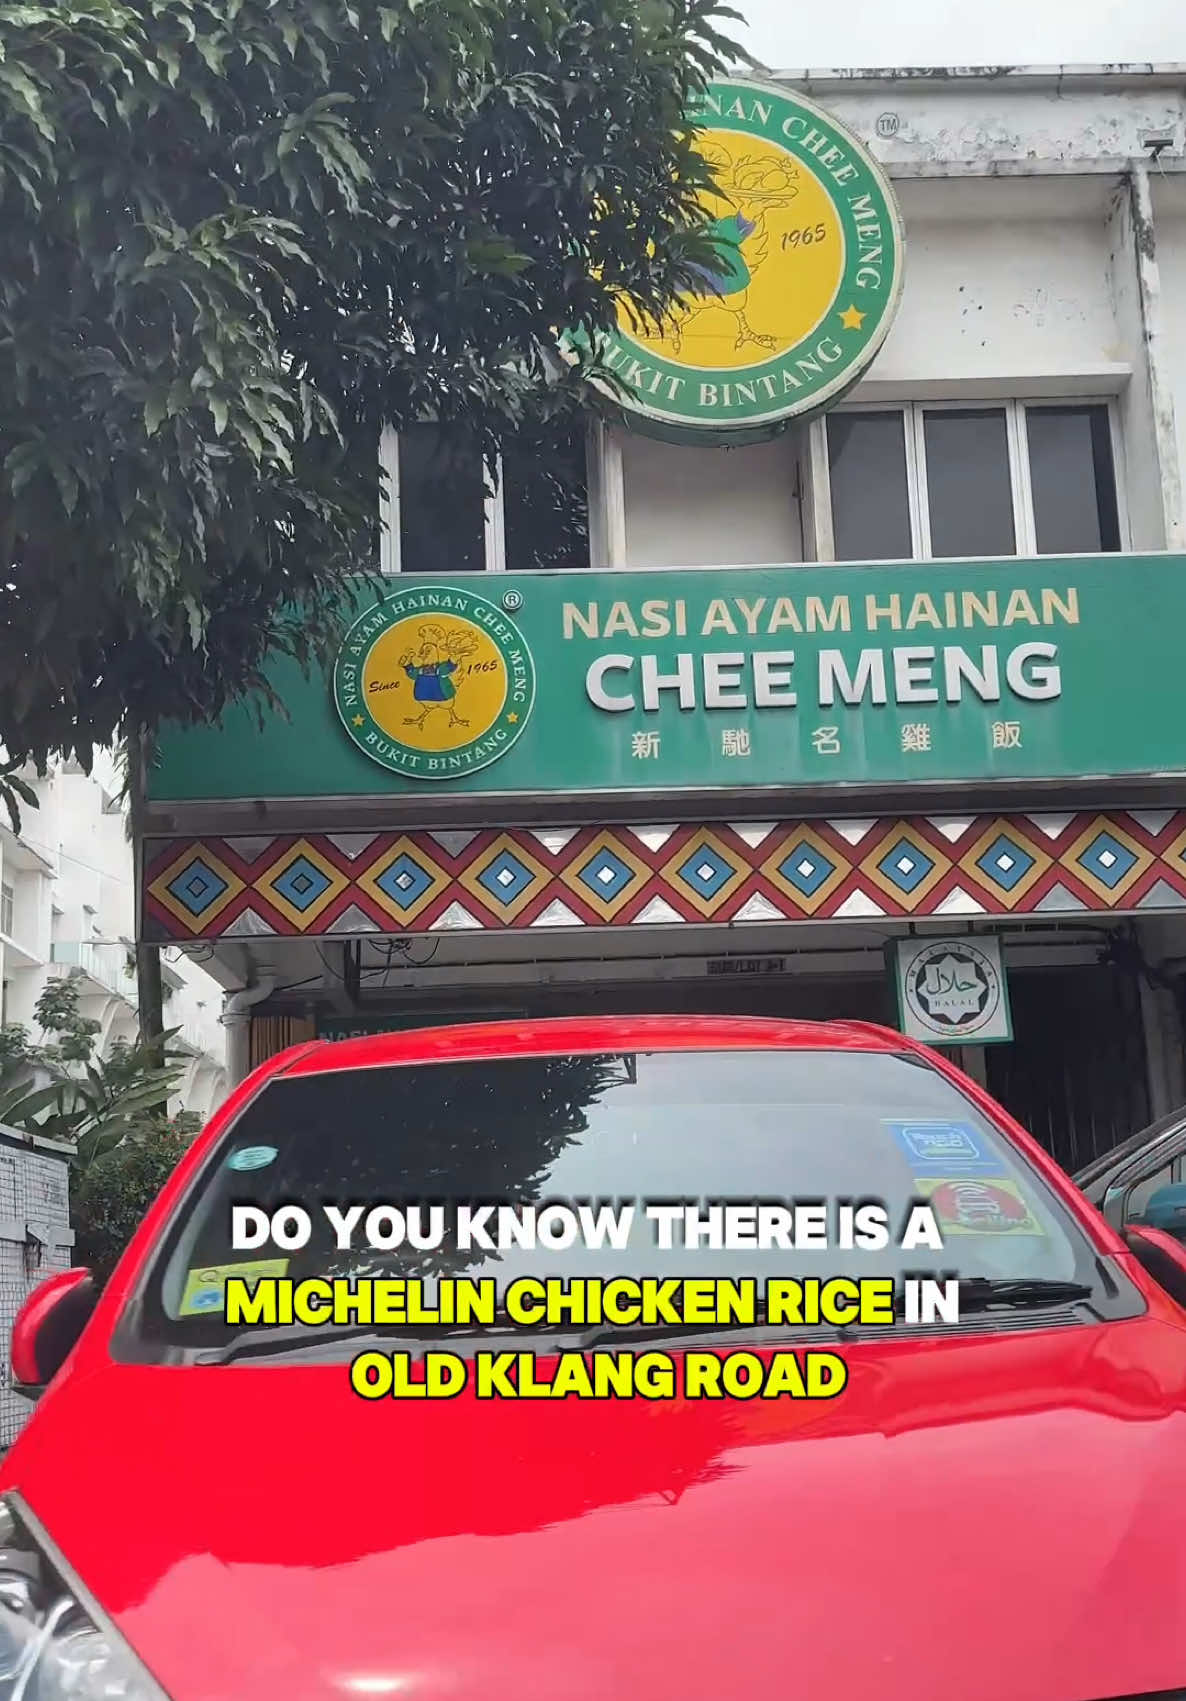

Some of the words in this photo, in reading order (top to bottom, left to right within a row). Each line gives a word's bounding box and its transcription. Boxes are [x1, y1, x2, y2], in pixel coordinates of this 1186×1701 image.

[690, 93, 774, 127] NAN
[782, 115, 860, 188] CHEE
[846, 192, 884, 291] MENG
[780, 223, 827, 251] 1965
[699, 336, 844, 408] BINTANG
[561, 599, 688, 640] NASI
[701, 595, 853, 636] AYAM
[865, 587, 1080, 631] HAINAN
[343, 663, 357, 706] NASI
[350, 612, 390, 656] AYAM
[391, 594, 469, 615] HAINAN
[473, 606, 514, 645] CHEE
[508, 649, 527, 703] MENG
[368, 680, 400, 693] Since
[466, 660, 498, 675] 1965
[584, 649, 798, 713] CHEE
[817, 641, 1063, 710] MENG
[365, 731, 421, 769] BUKIT
[428, 729, 508, 770] BINTANG
[631, 720, 1024, 761] 新馳名雞飯
[926, 967, 977, 995] حلال
[934, 999, 975, 1007] HALAL
